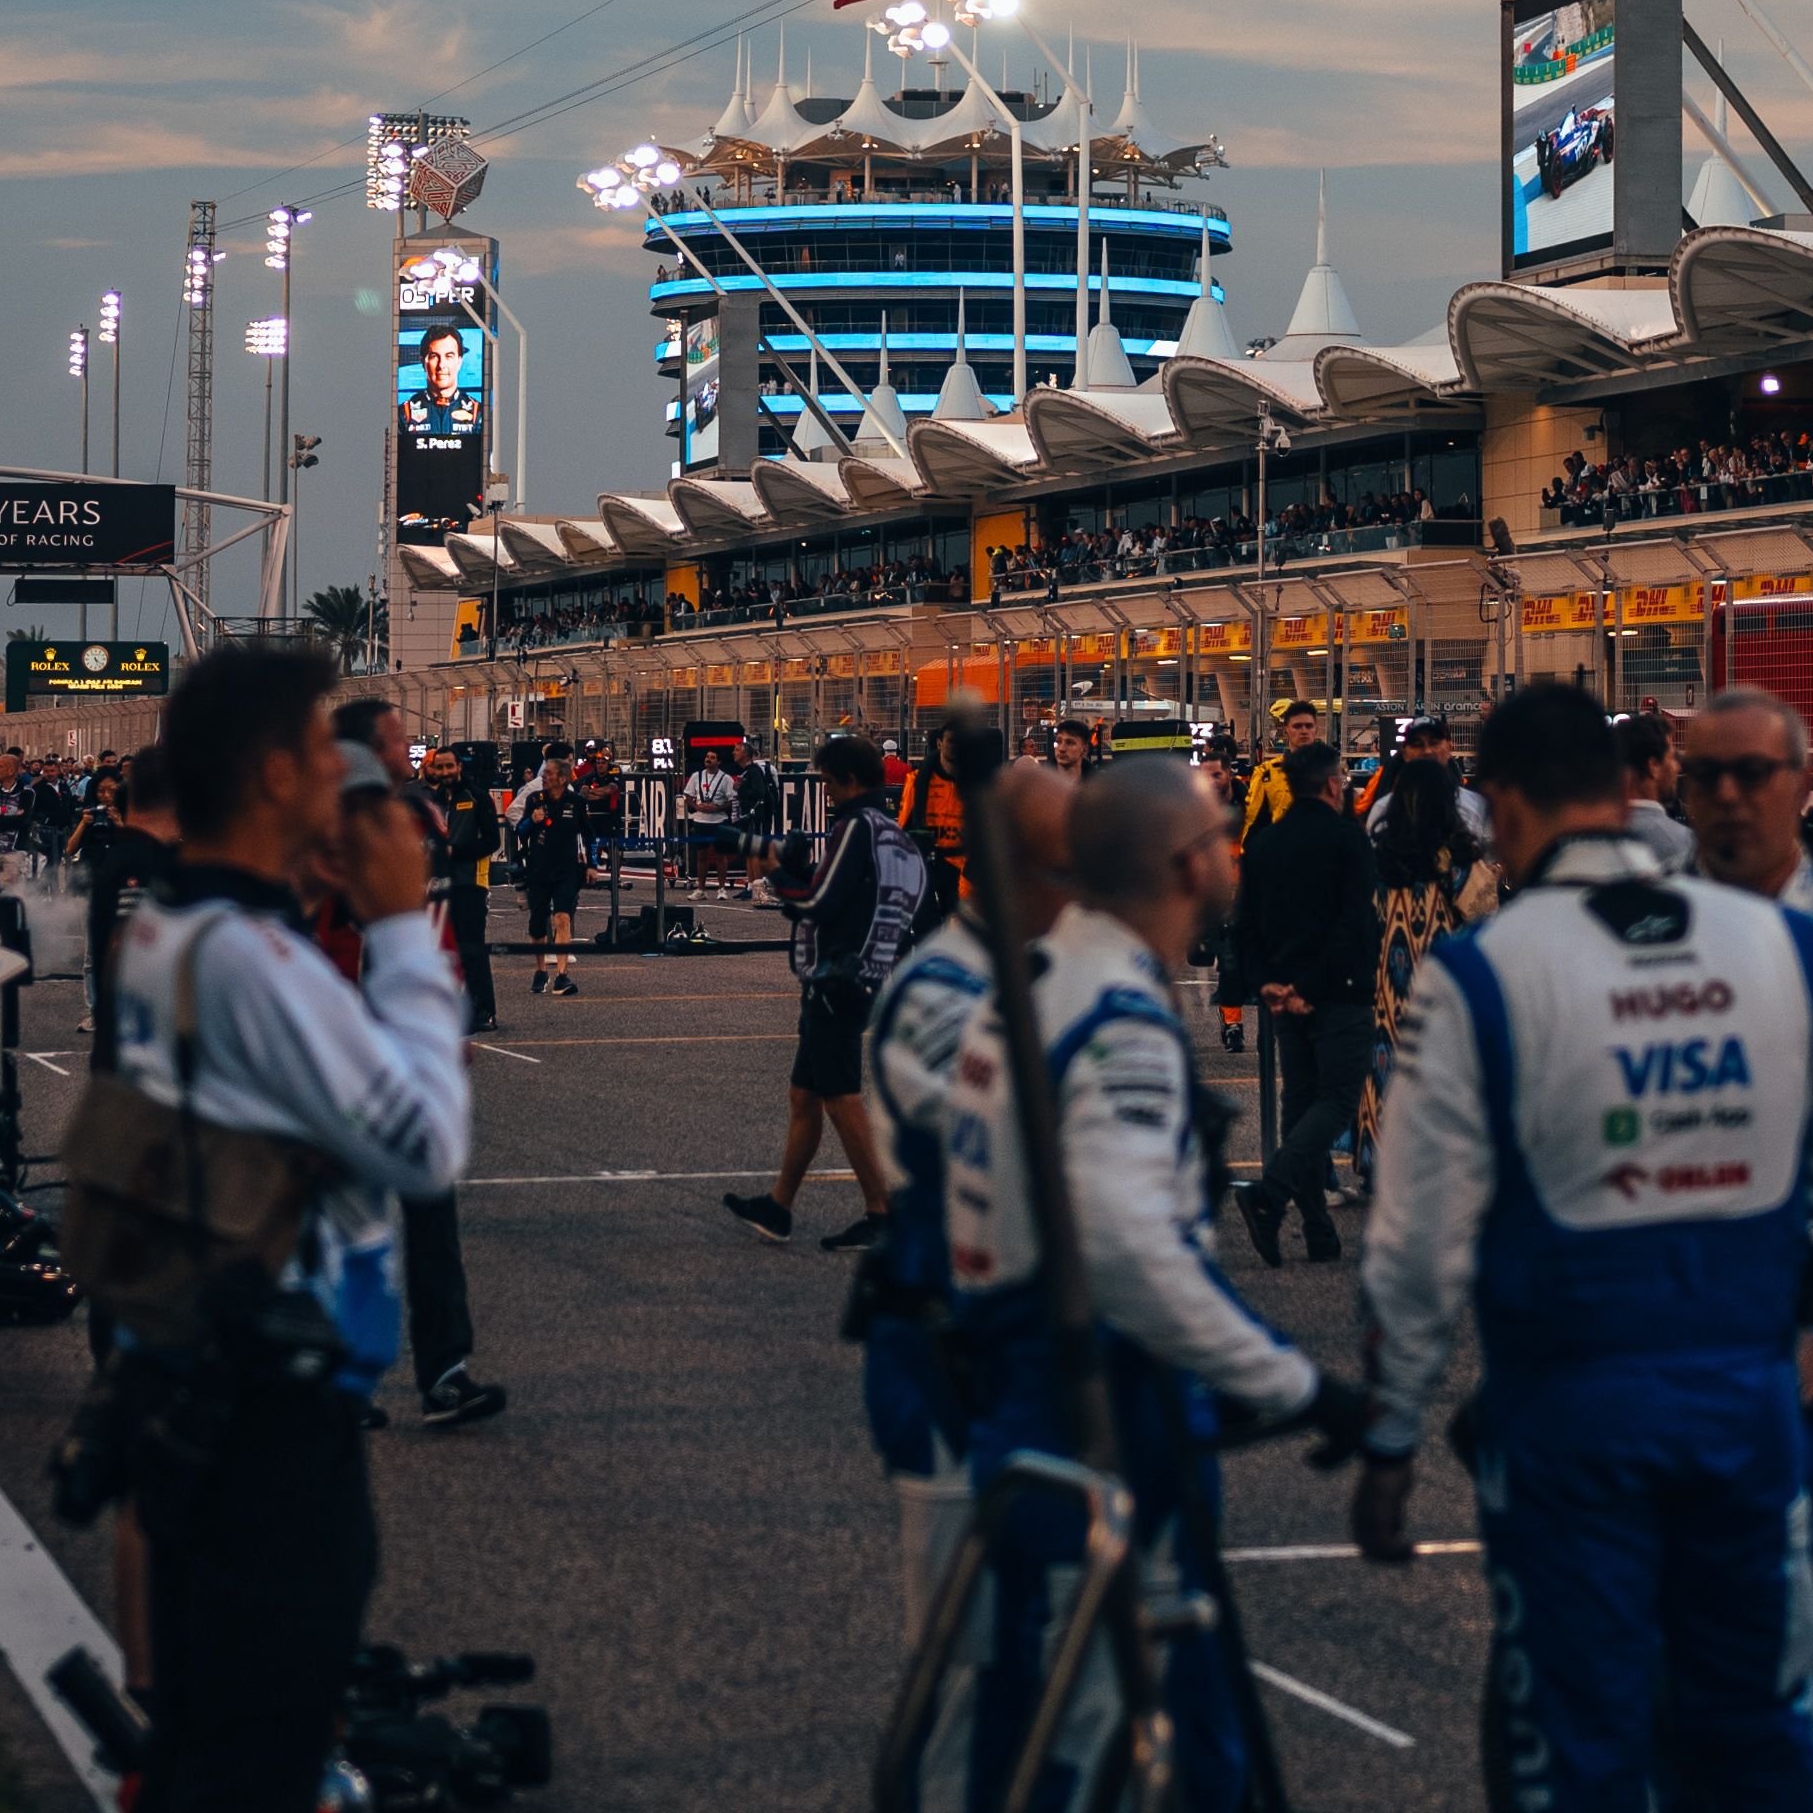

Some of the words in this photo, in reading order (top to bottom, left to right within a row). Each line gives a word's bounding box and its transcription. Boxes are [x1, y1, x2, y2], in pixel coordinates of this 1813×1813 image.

[429, 438, 462, 449] Perez
[27, 534, 94, 547] RACING
[1636, 589, 1669, 617] DHL
[31, 662, 70, 671] ROLEX
[121, 662, 160, 671] ROLEX
[1375, 703, 1405, 711] ASTON
[639, 778, 666, 848] AIR
[1611, 978, 1733, 1022] HUGO
[1608, 1036, 1752, 1098] VISA
